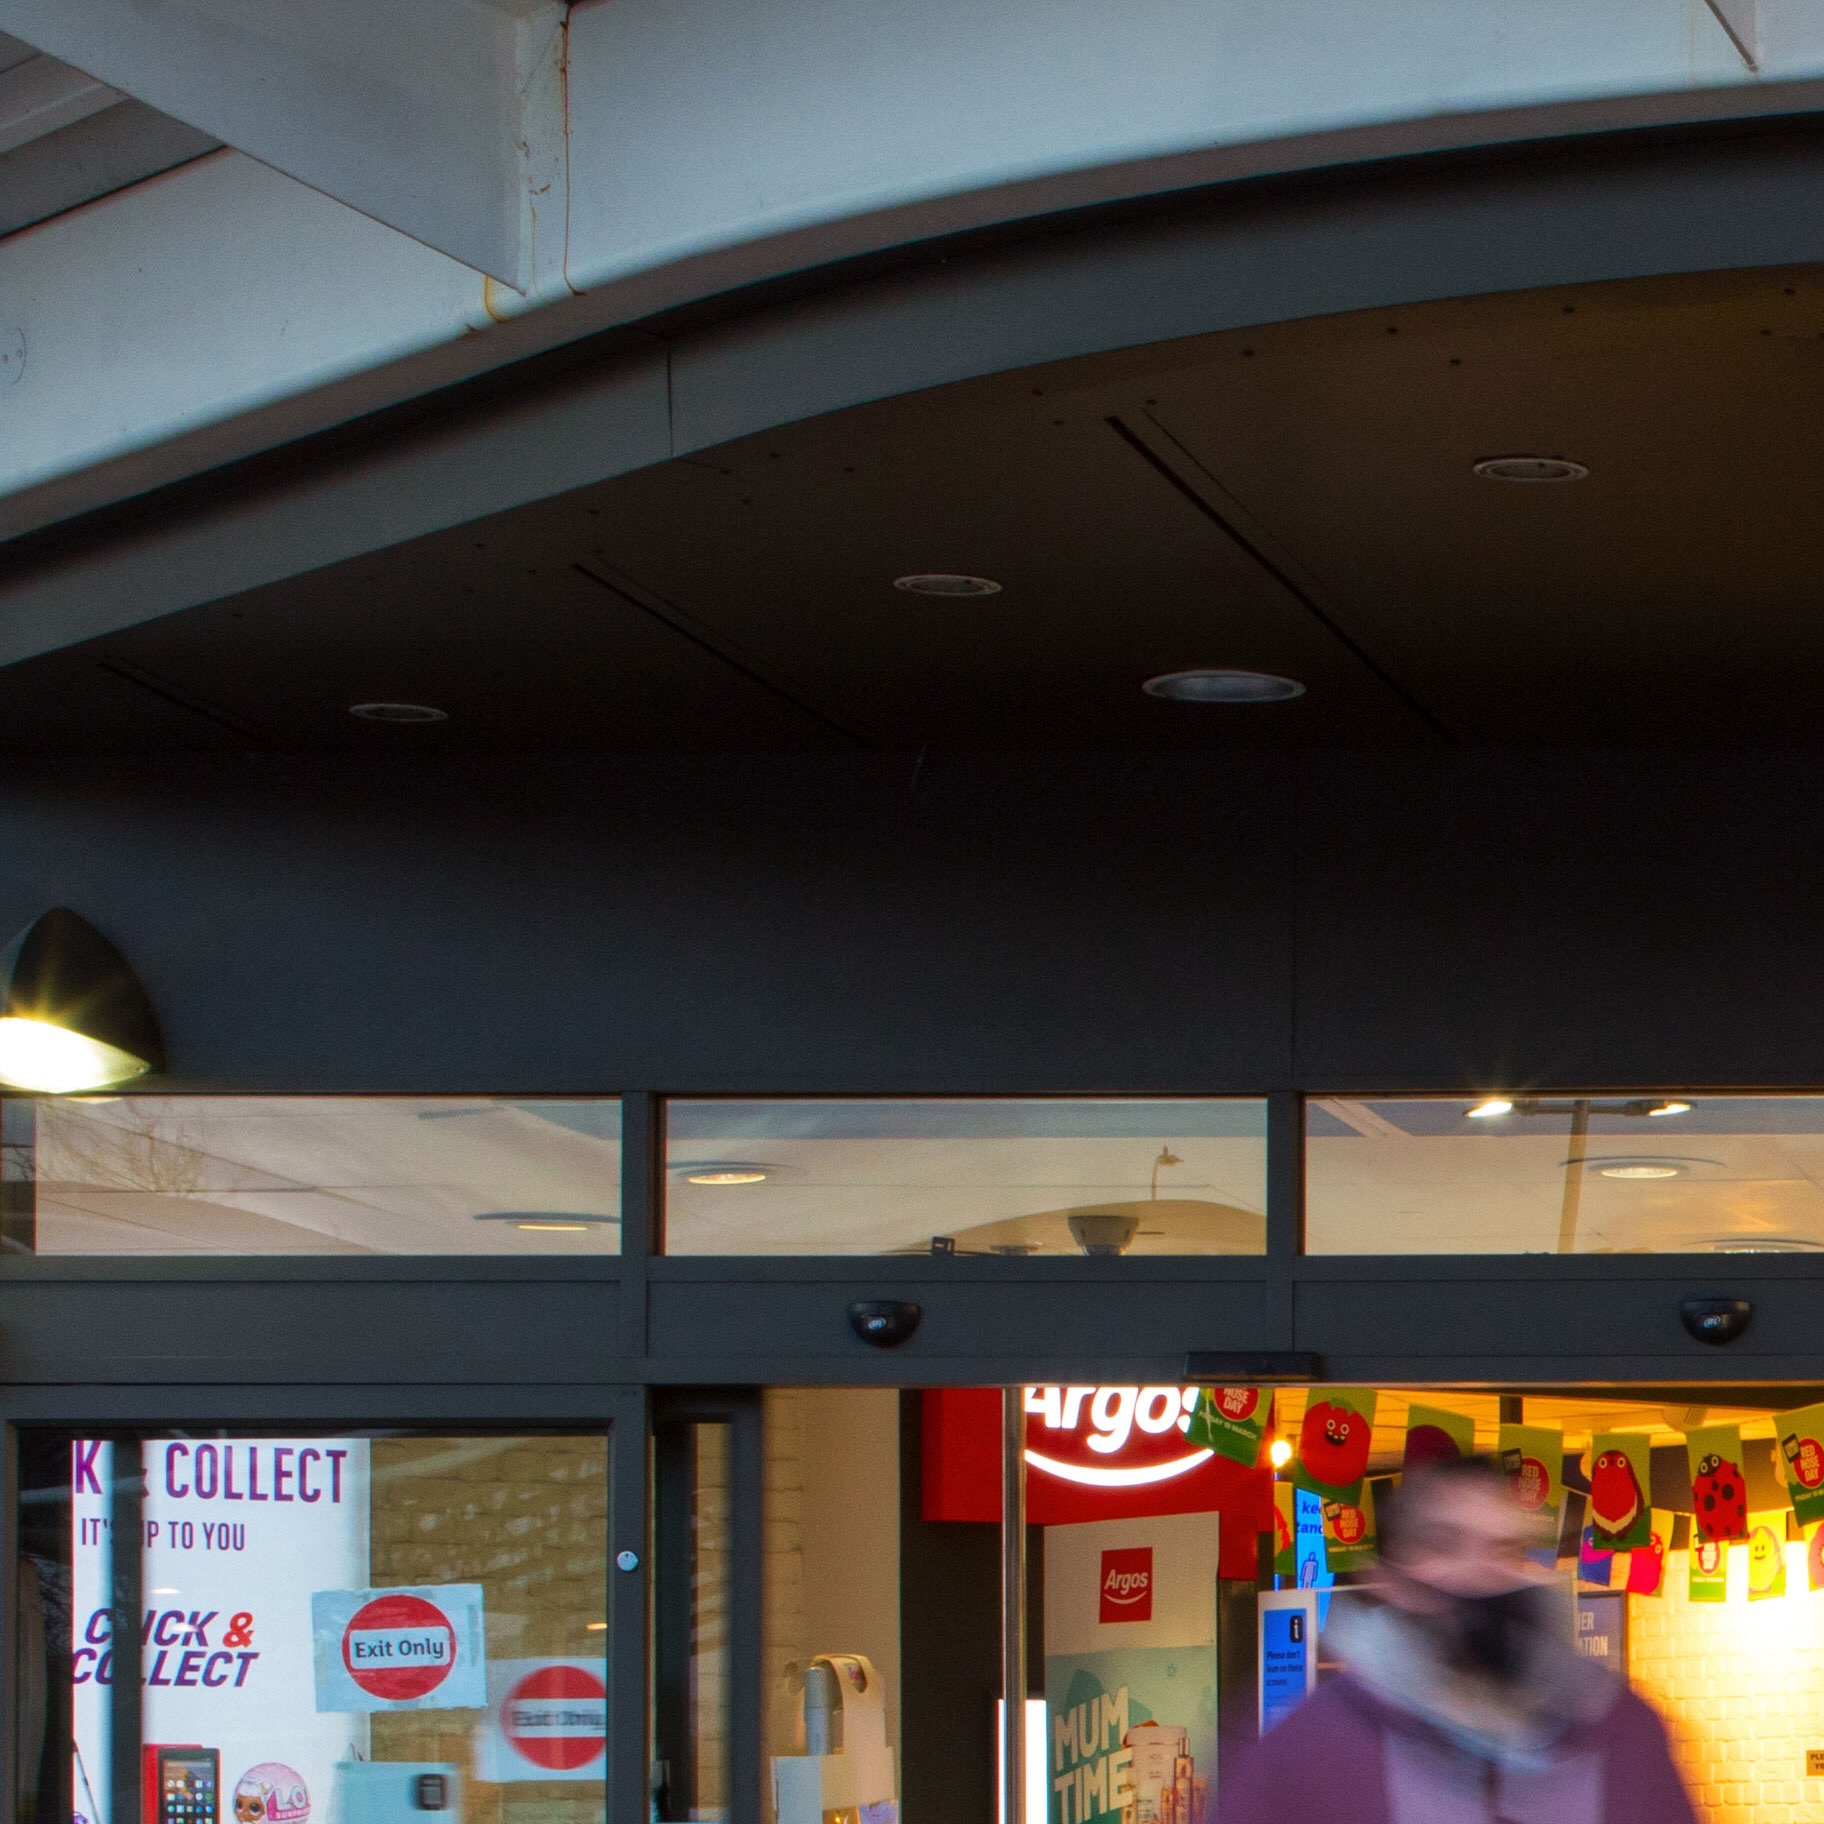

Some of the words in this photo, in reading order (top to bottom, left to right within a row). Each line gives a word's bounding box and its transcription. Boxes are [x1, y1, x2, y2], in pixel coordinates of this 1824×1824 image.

[1223, 1397, 1245, 1415] DAY
[1800, 1444, 1815, 1457] RED
[165, 1442, 348, 1503] COLLECT
[81, 1517, 112, 1546] IT'
[167, 1521, 194, 1550] TO
[202, 1522, 246, 1551] YOU
[1104, 1569, 1148, 1596] Argos
[85, 1608, 220, 1648] CICK
[222, 1611, 254, 1649] &
[354, 1640, 394, 1659] Exit
[398, 1638, 445, 1660] Only
[72, 1648, 261, 1688] COLECT
[1053, 1685, 1129, 1772] MUM
